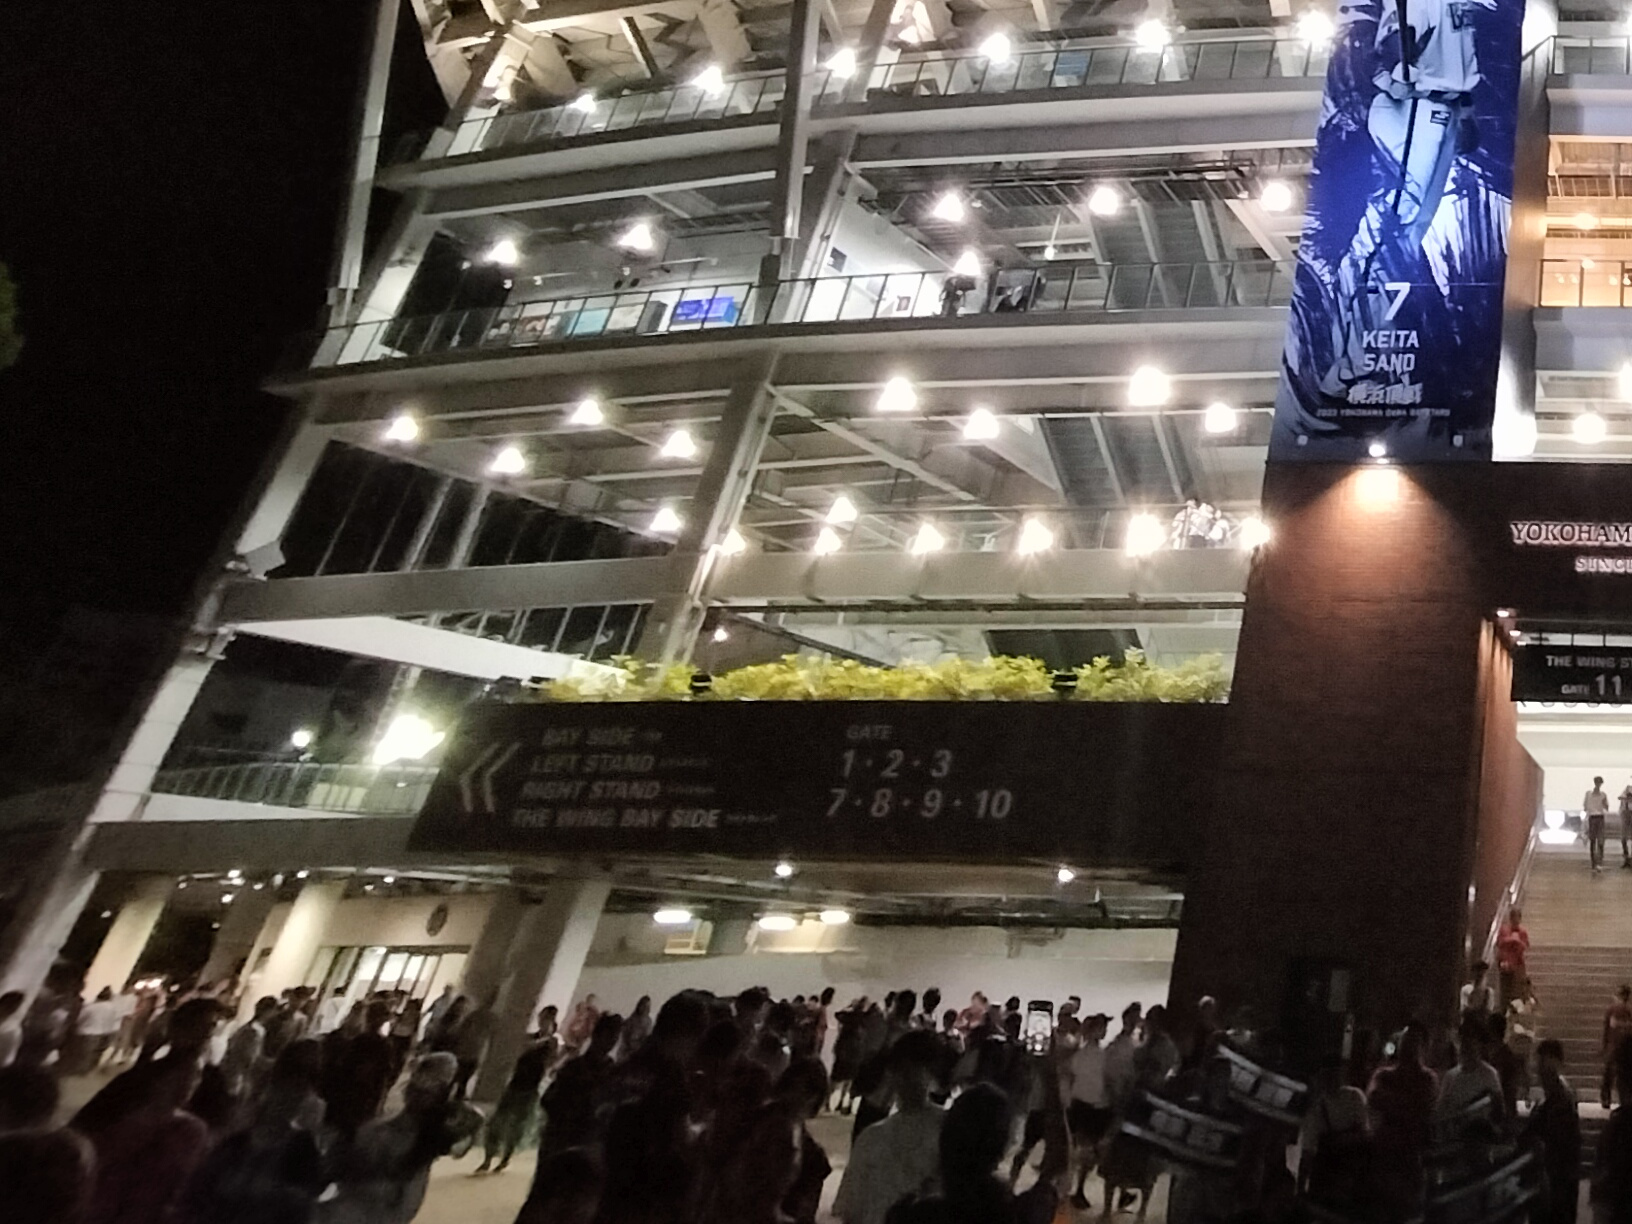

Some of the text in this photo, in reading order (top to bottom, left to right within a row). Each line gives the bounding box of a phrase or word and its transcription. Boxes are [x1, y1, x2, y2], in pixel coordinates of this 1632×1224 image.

[1385, 282, 1411, 321] 7
[1362, 330, 1420, 348] KEITA
[1545, 655, 1573, 668] THE
[1576, 656, 1616, 668] WING
[1595, 674, 1622, 696] 11
[846, 724, 893, 740] GATE
[530, 753, 582, 773] LEFT
[582, 753, 656, 773] STAND
[589, 780, 661, 800] STAND
[619, 808, 662, 828] BAY
[667, 808, 722, 828] SIDE
